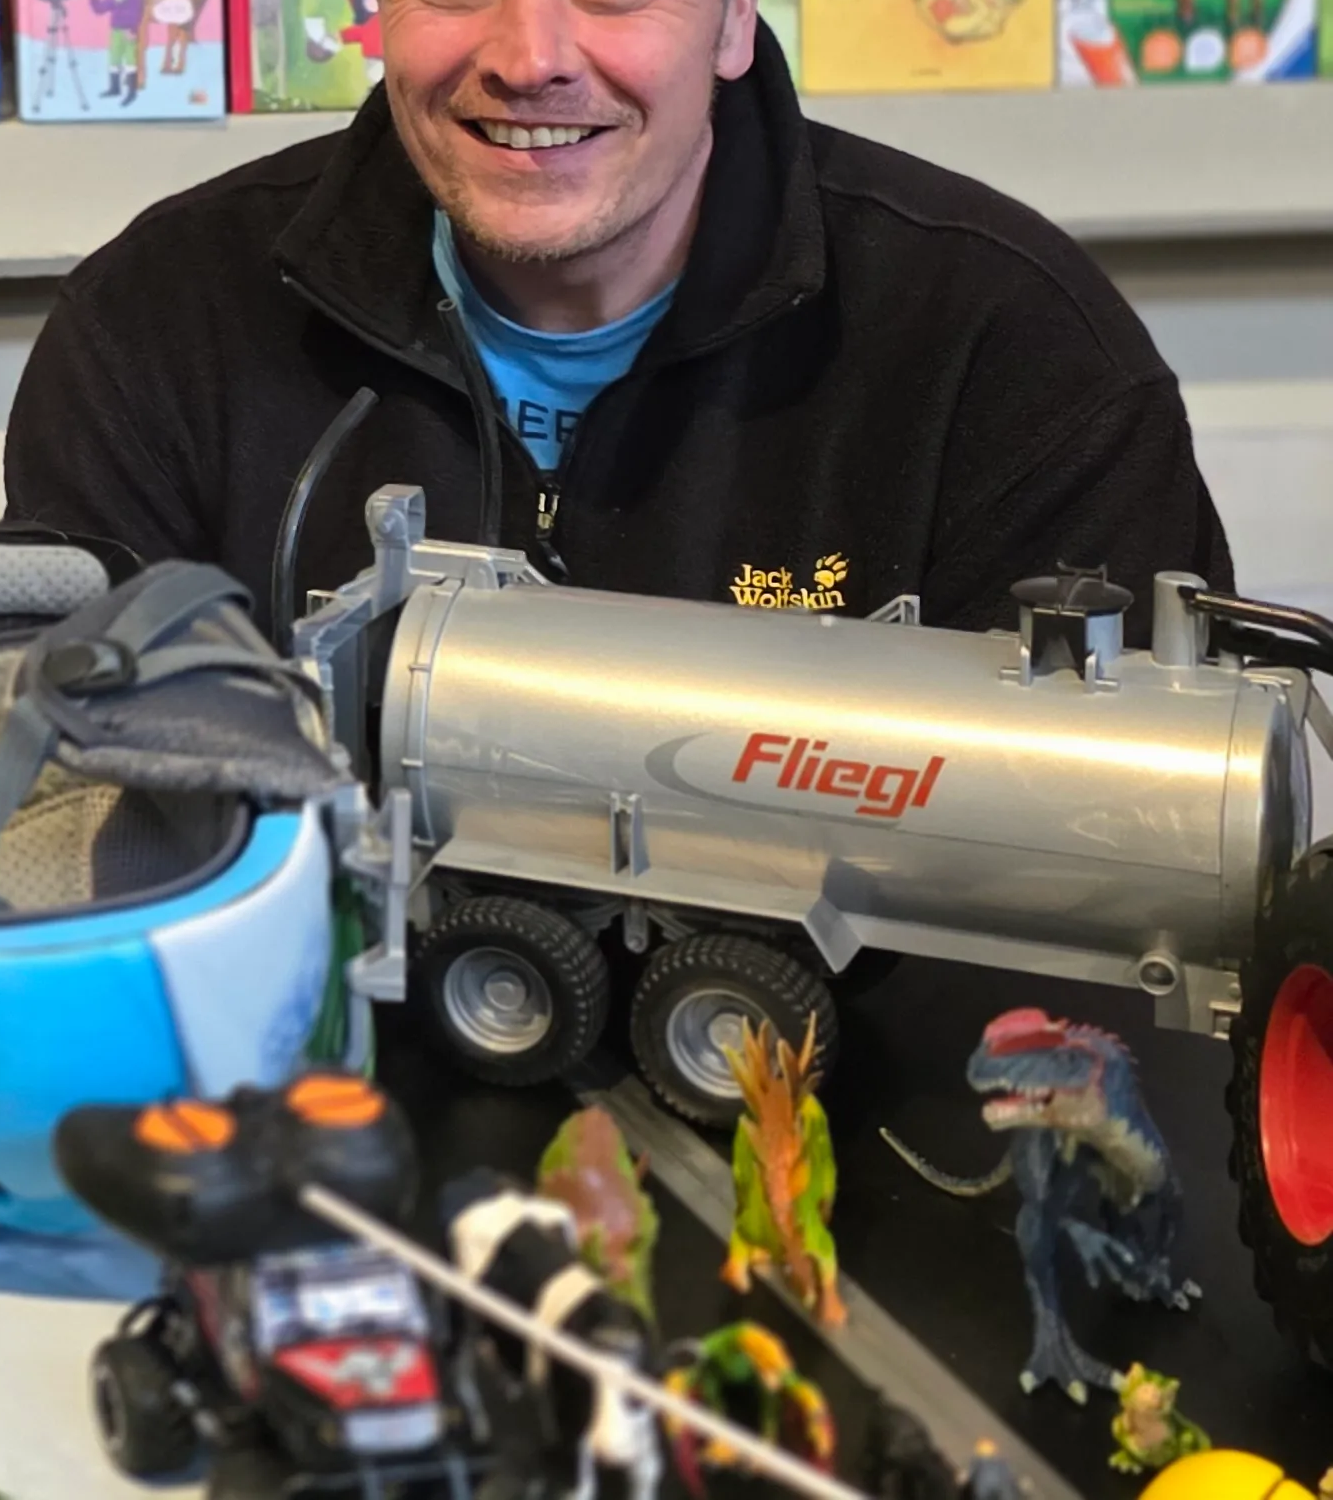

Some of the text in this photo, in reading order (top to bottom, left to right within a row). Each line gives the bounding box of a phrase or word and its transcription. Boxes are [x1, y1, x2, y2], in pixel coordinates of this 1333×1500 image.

[734, 563, 793, 588] Jack
[729, 585, 846, 610] Wolfskin
[731, 732, 945, 818] Fliegl
